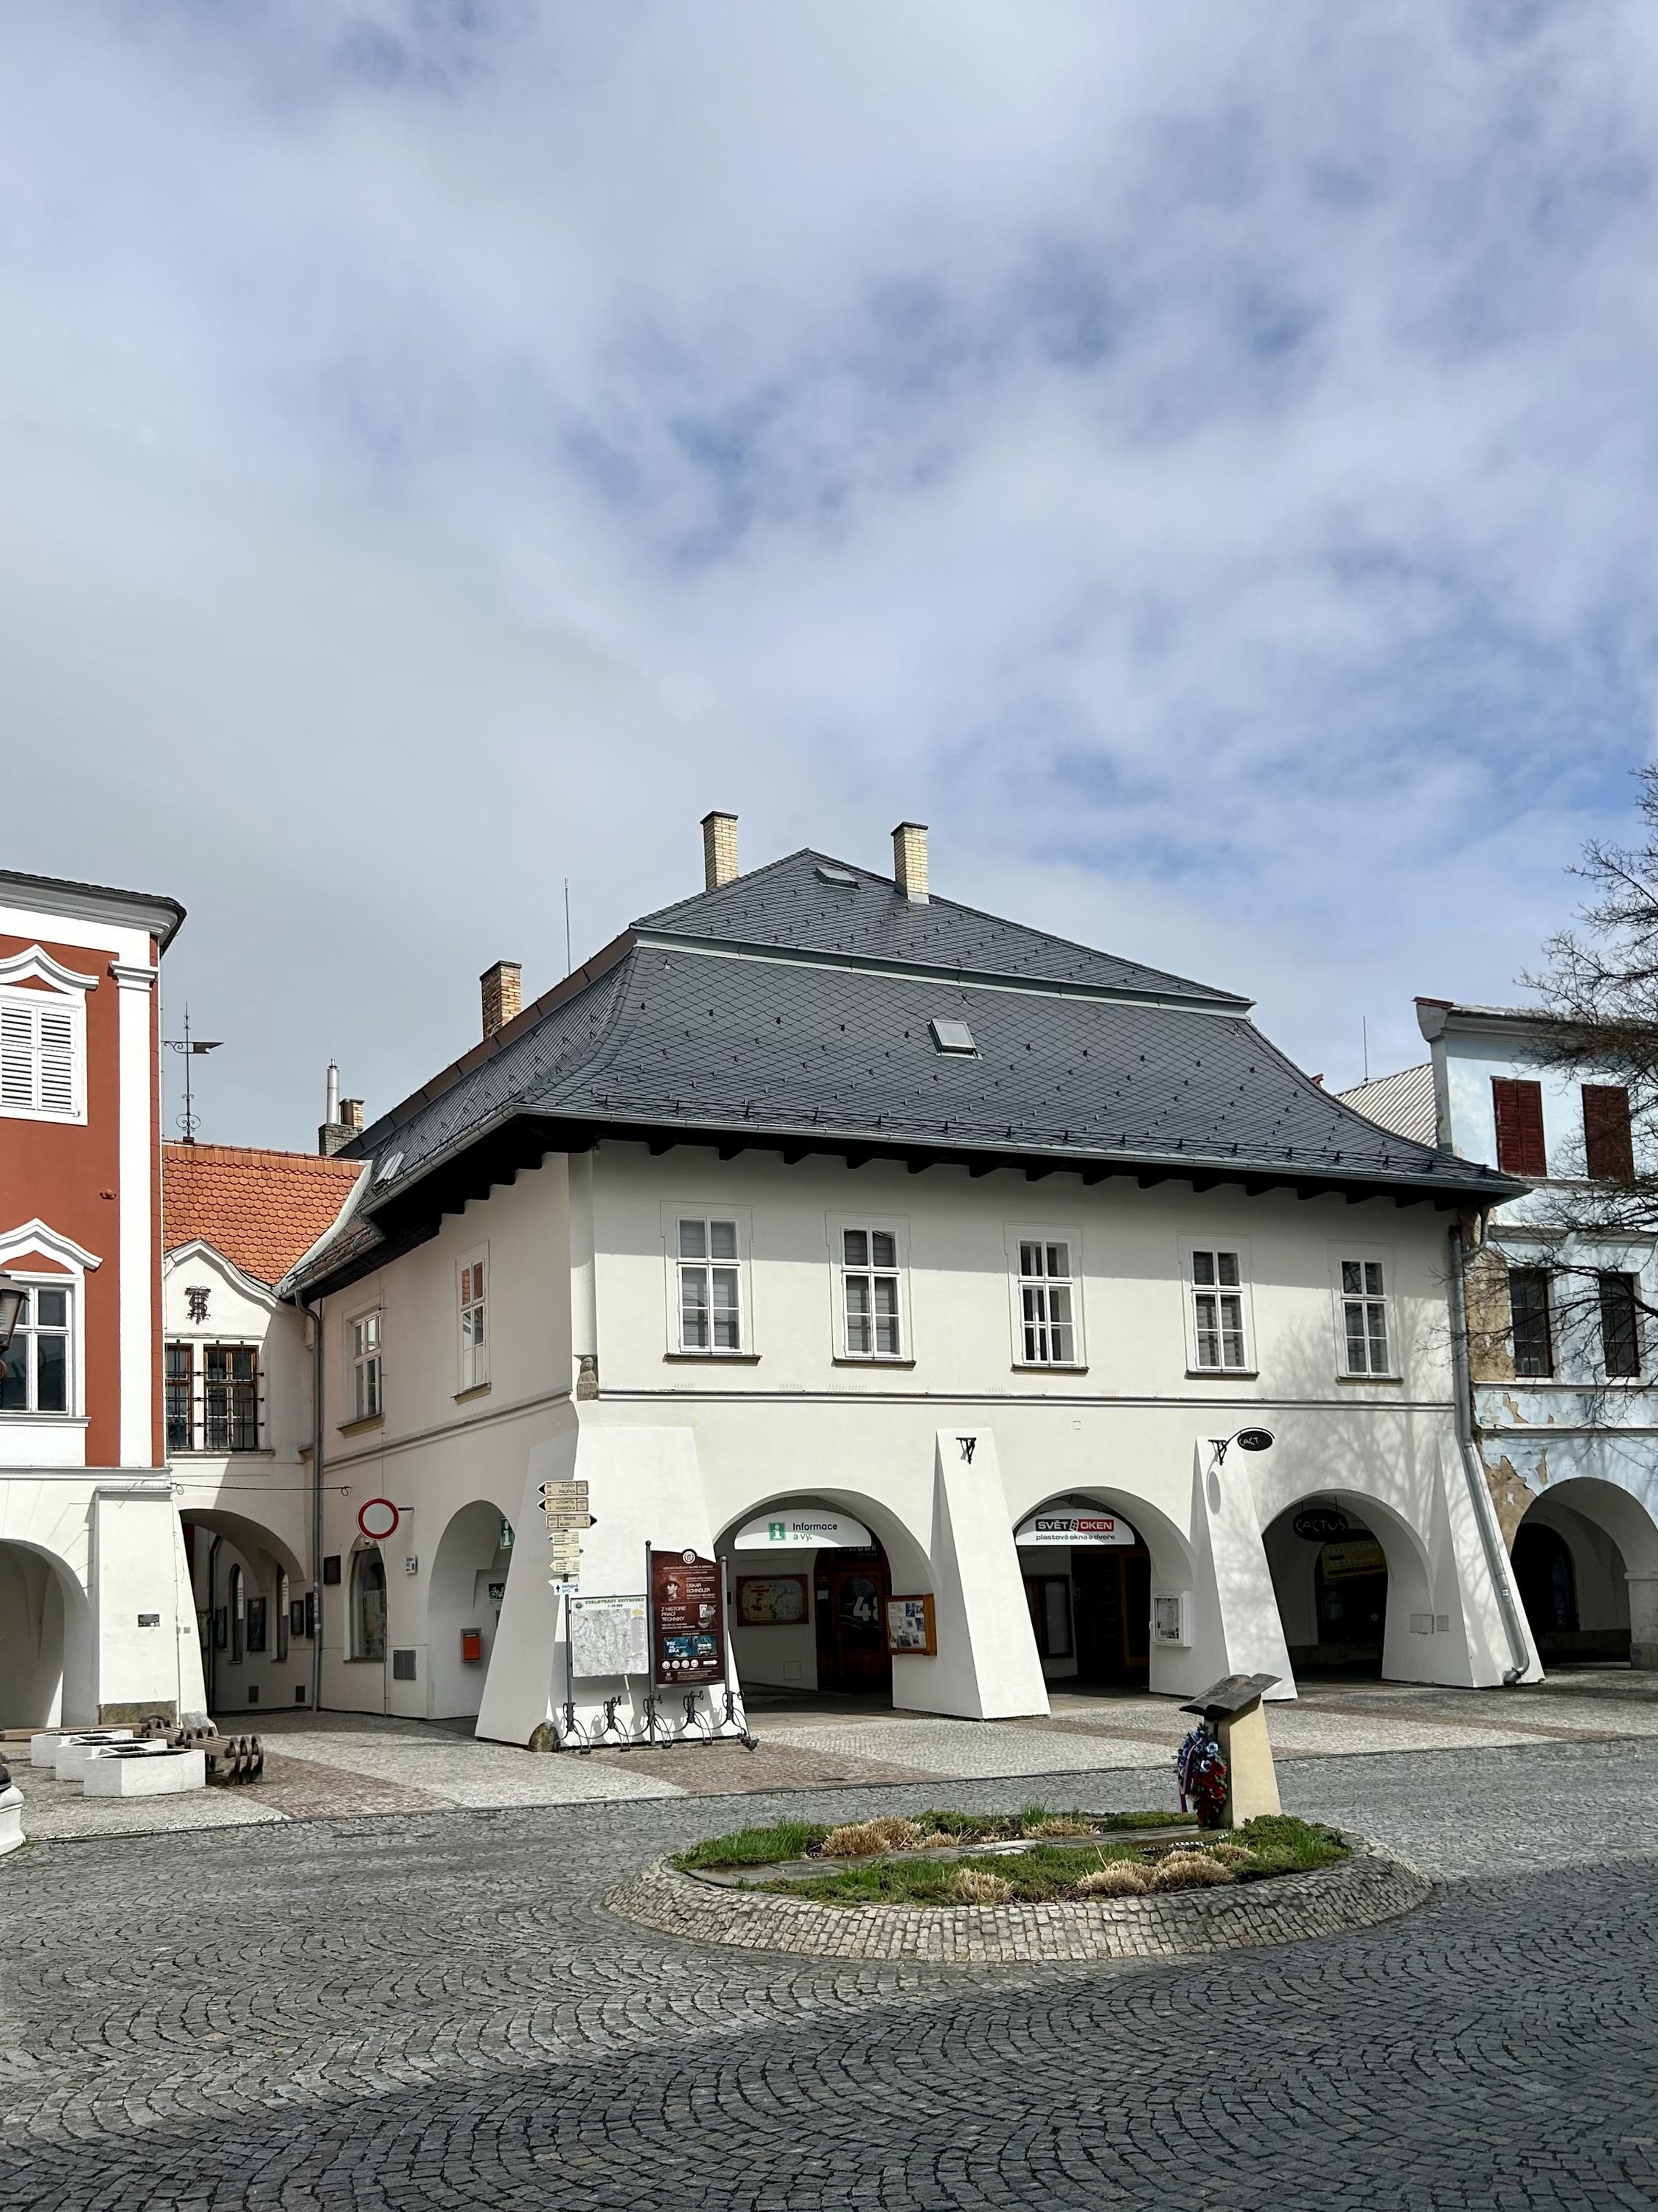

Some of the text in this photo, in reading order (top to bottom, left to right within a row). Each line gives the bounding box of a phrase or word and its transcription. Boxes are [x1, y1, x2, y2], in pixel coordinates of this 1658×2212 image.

[793, 1522, 837, 1531] Informace
[1038, 1520, 1112, 1530] SVĚT OKEN
[1296, 1519, 1345, 1532] CACTUS
